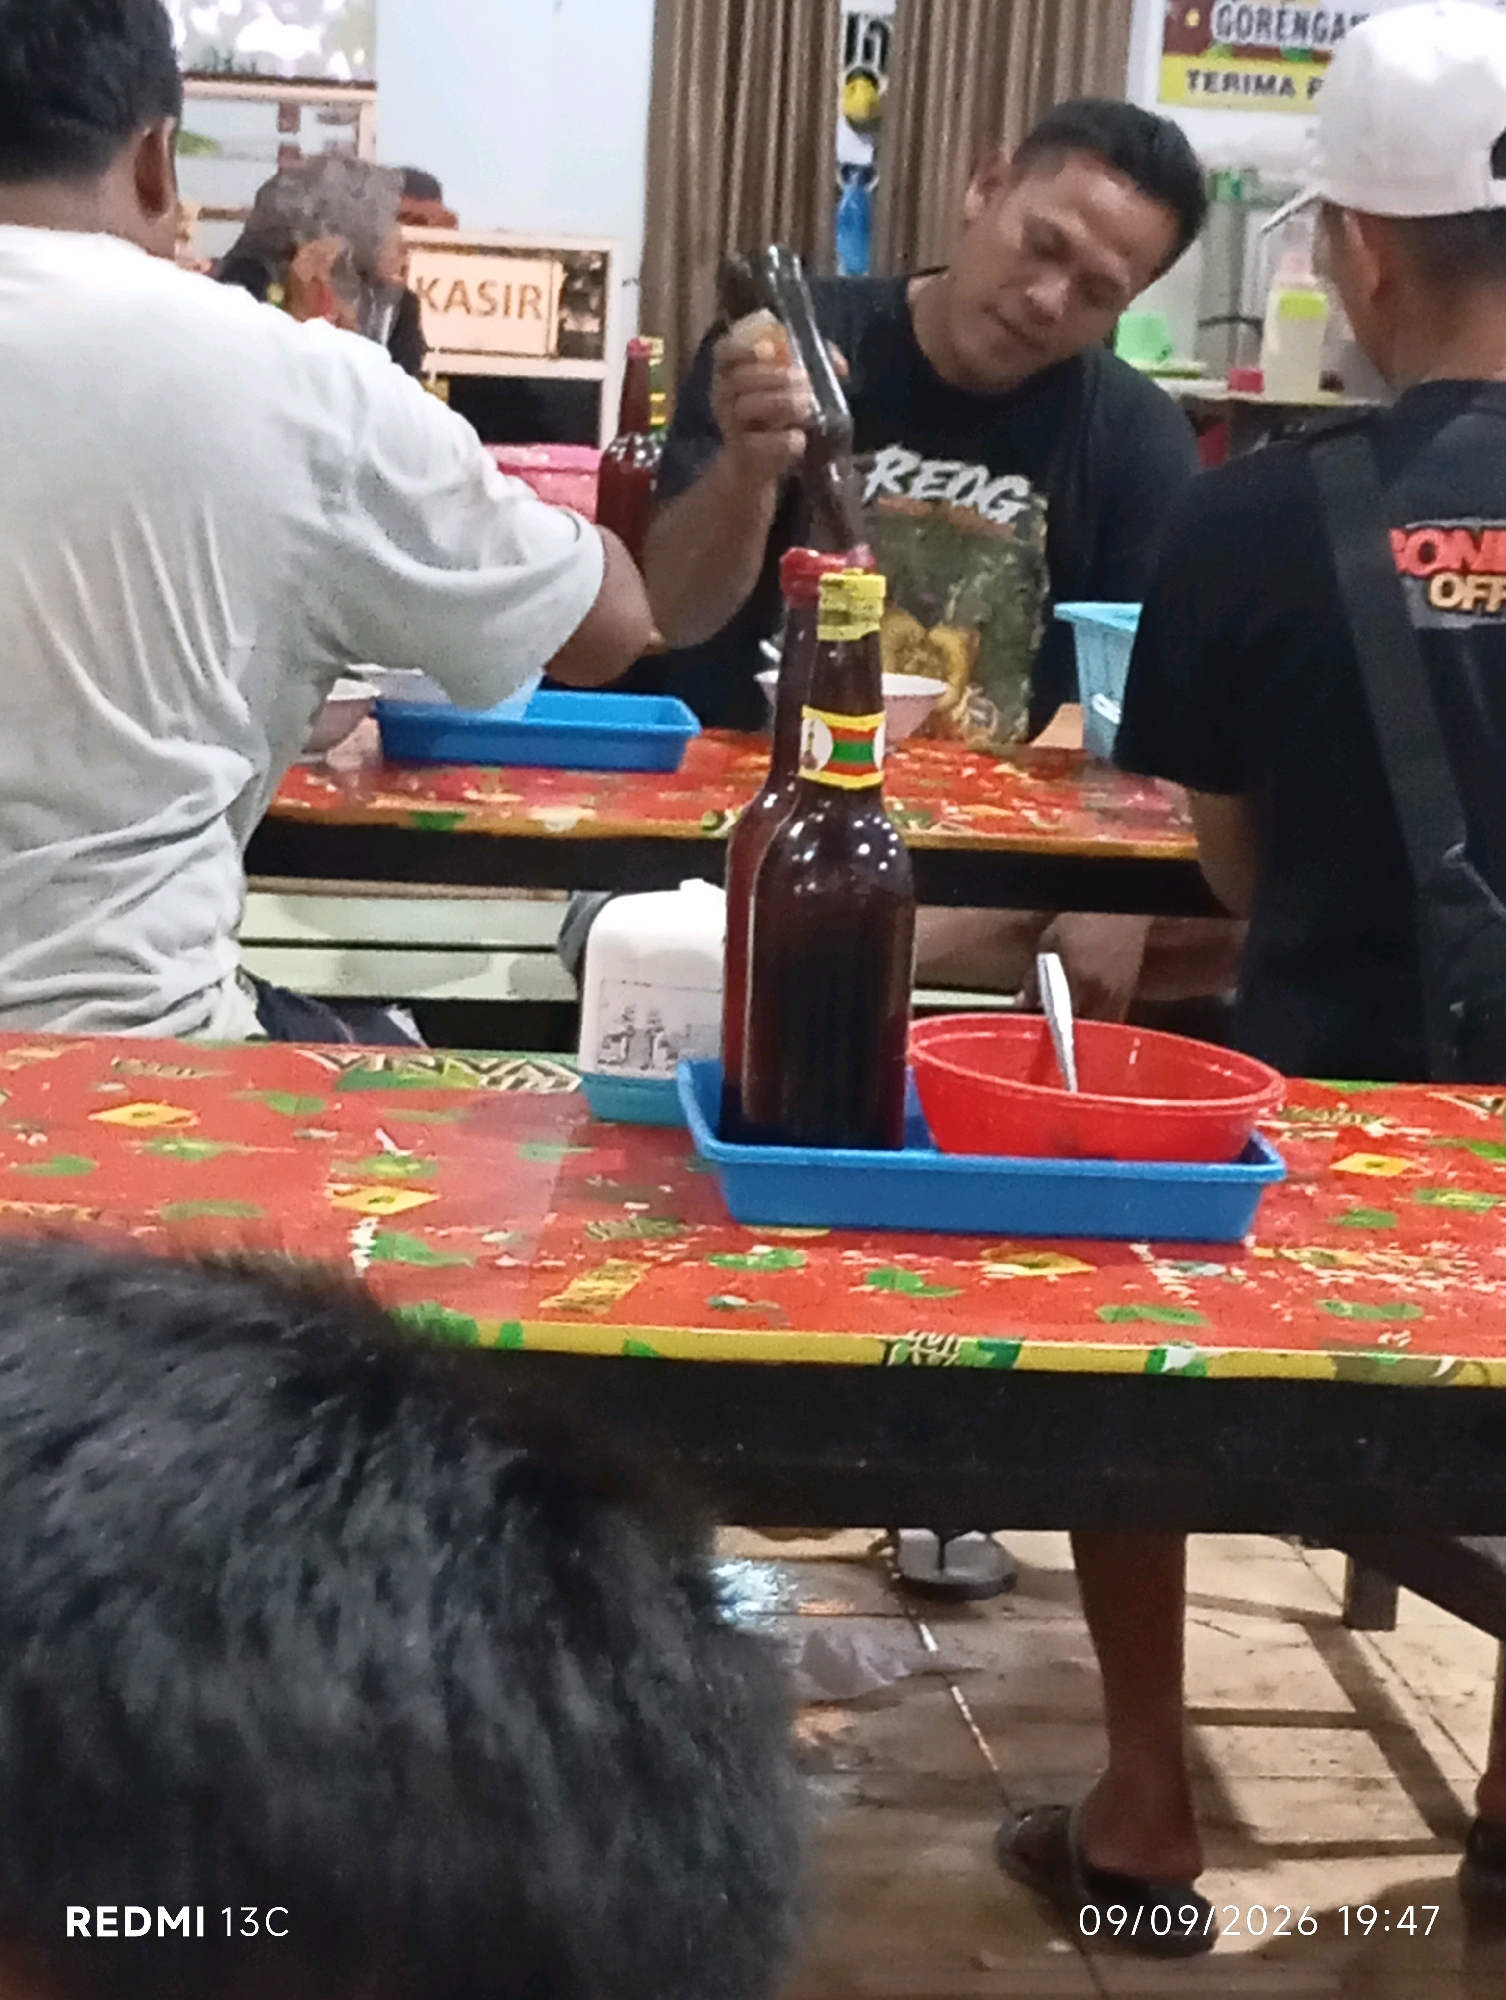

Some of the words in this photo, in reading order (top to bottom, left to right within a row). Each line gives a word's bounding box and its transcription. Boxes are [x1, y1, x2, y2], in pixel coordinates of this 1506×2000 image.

[1186, 69, 1296, 99] TERIMA
[416, 275, 544, 320] KASIR
[861, 444, 1032, 525] REOG
